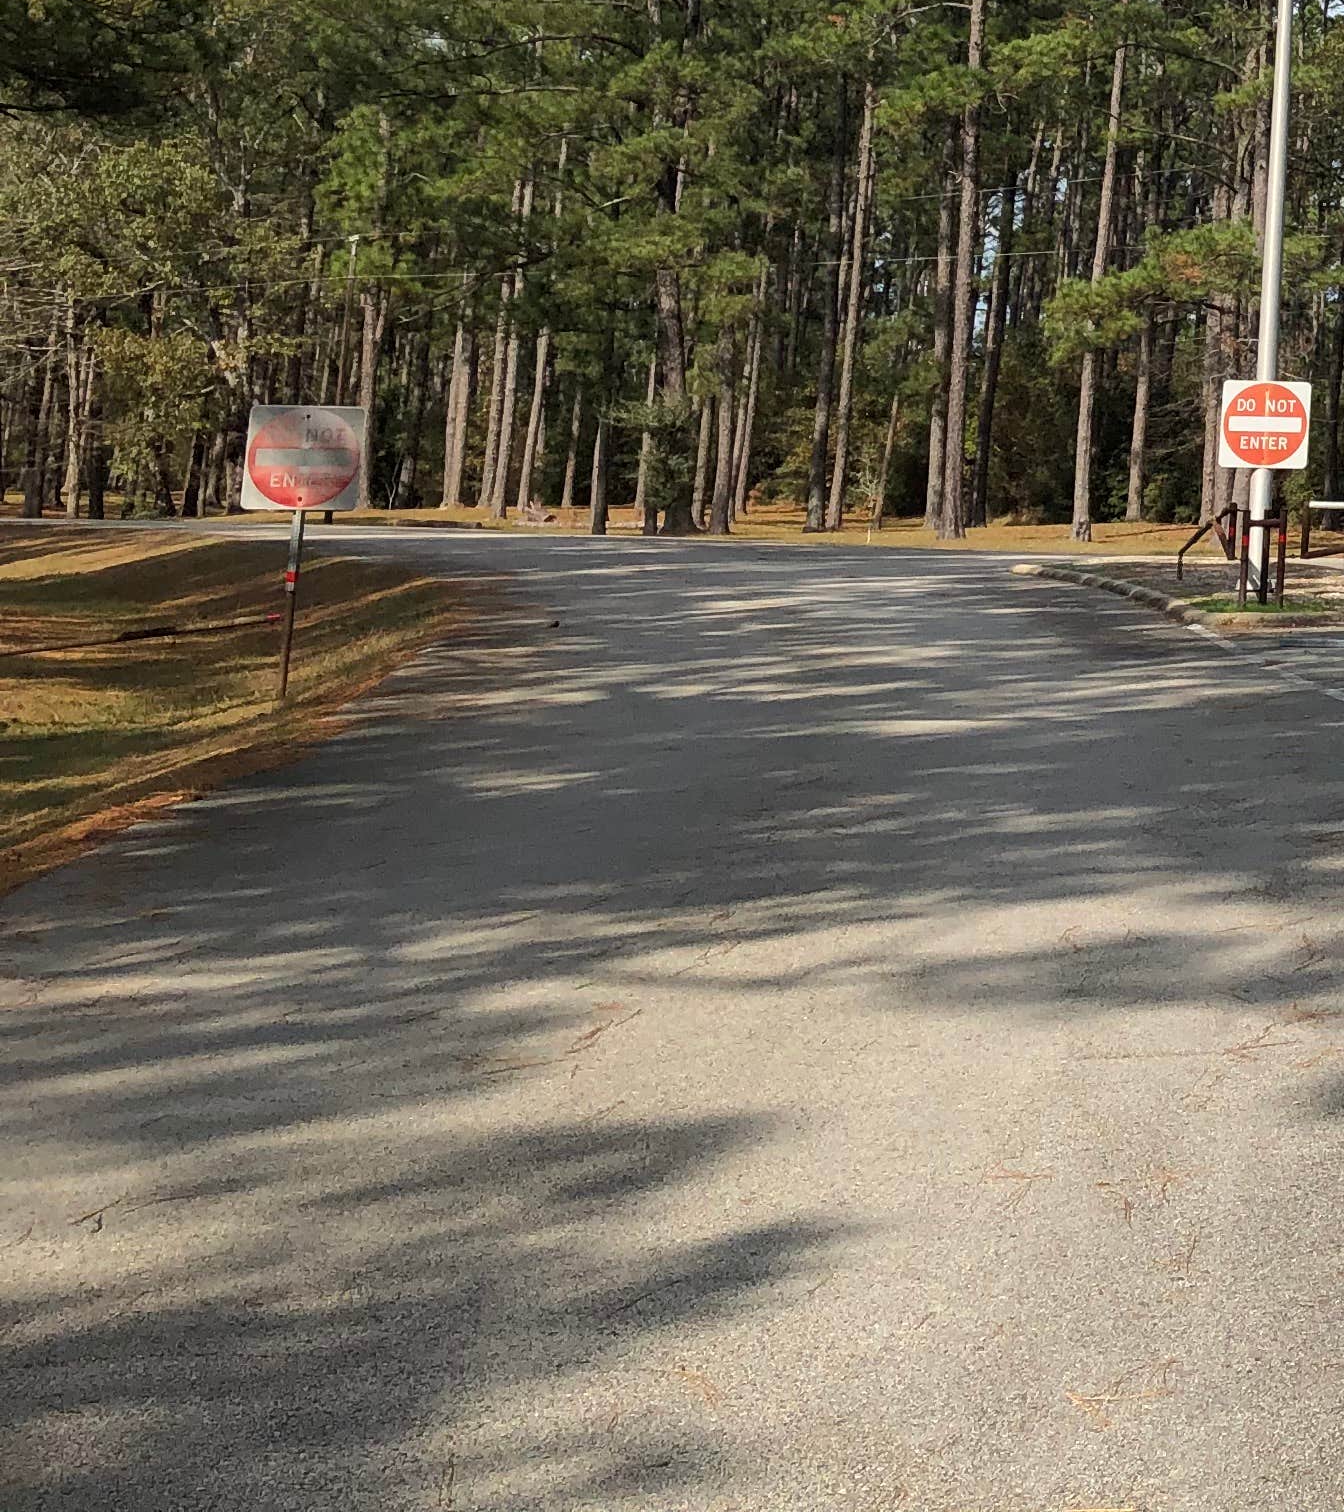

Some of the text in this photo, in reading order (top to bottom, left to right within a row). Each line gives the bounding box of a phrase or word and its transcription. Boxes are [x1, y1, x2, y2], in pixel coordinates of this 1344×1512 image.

[1236, 398, 1297, 413] DO NOT
[1239, 435, 1288, 450] ENTER
